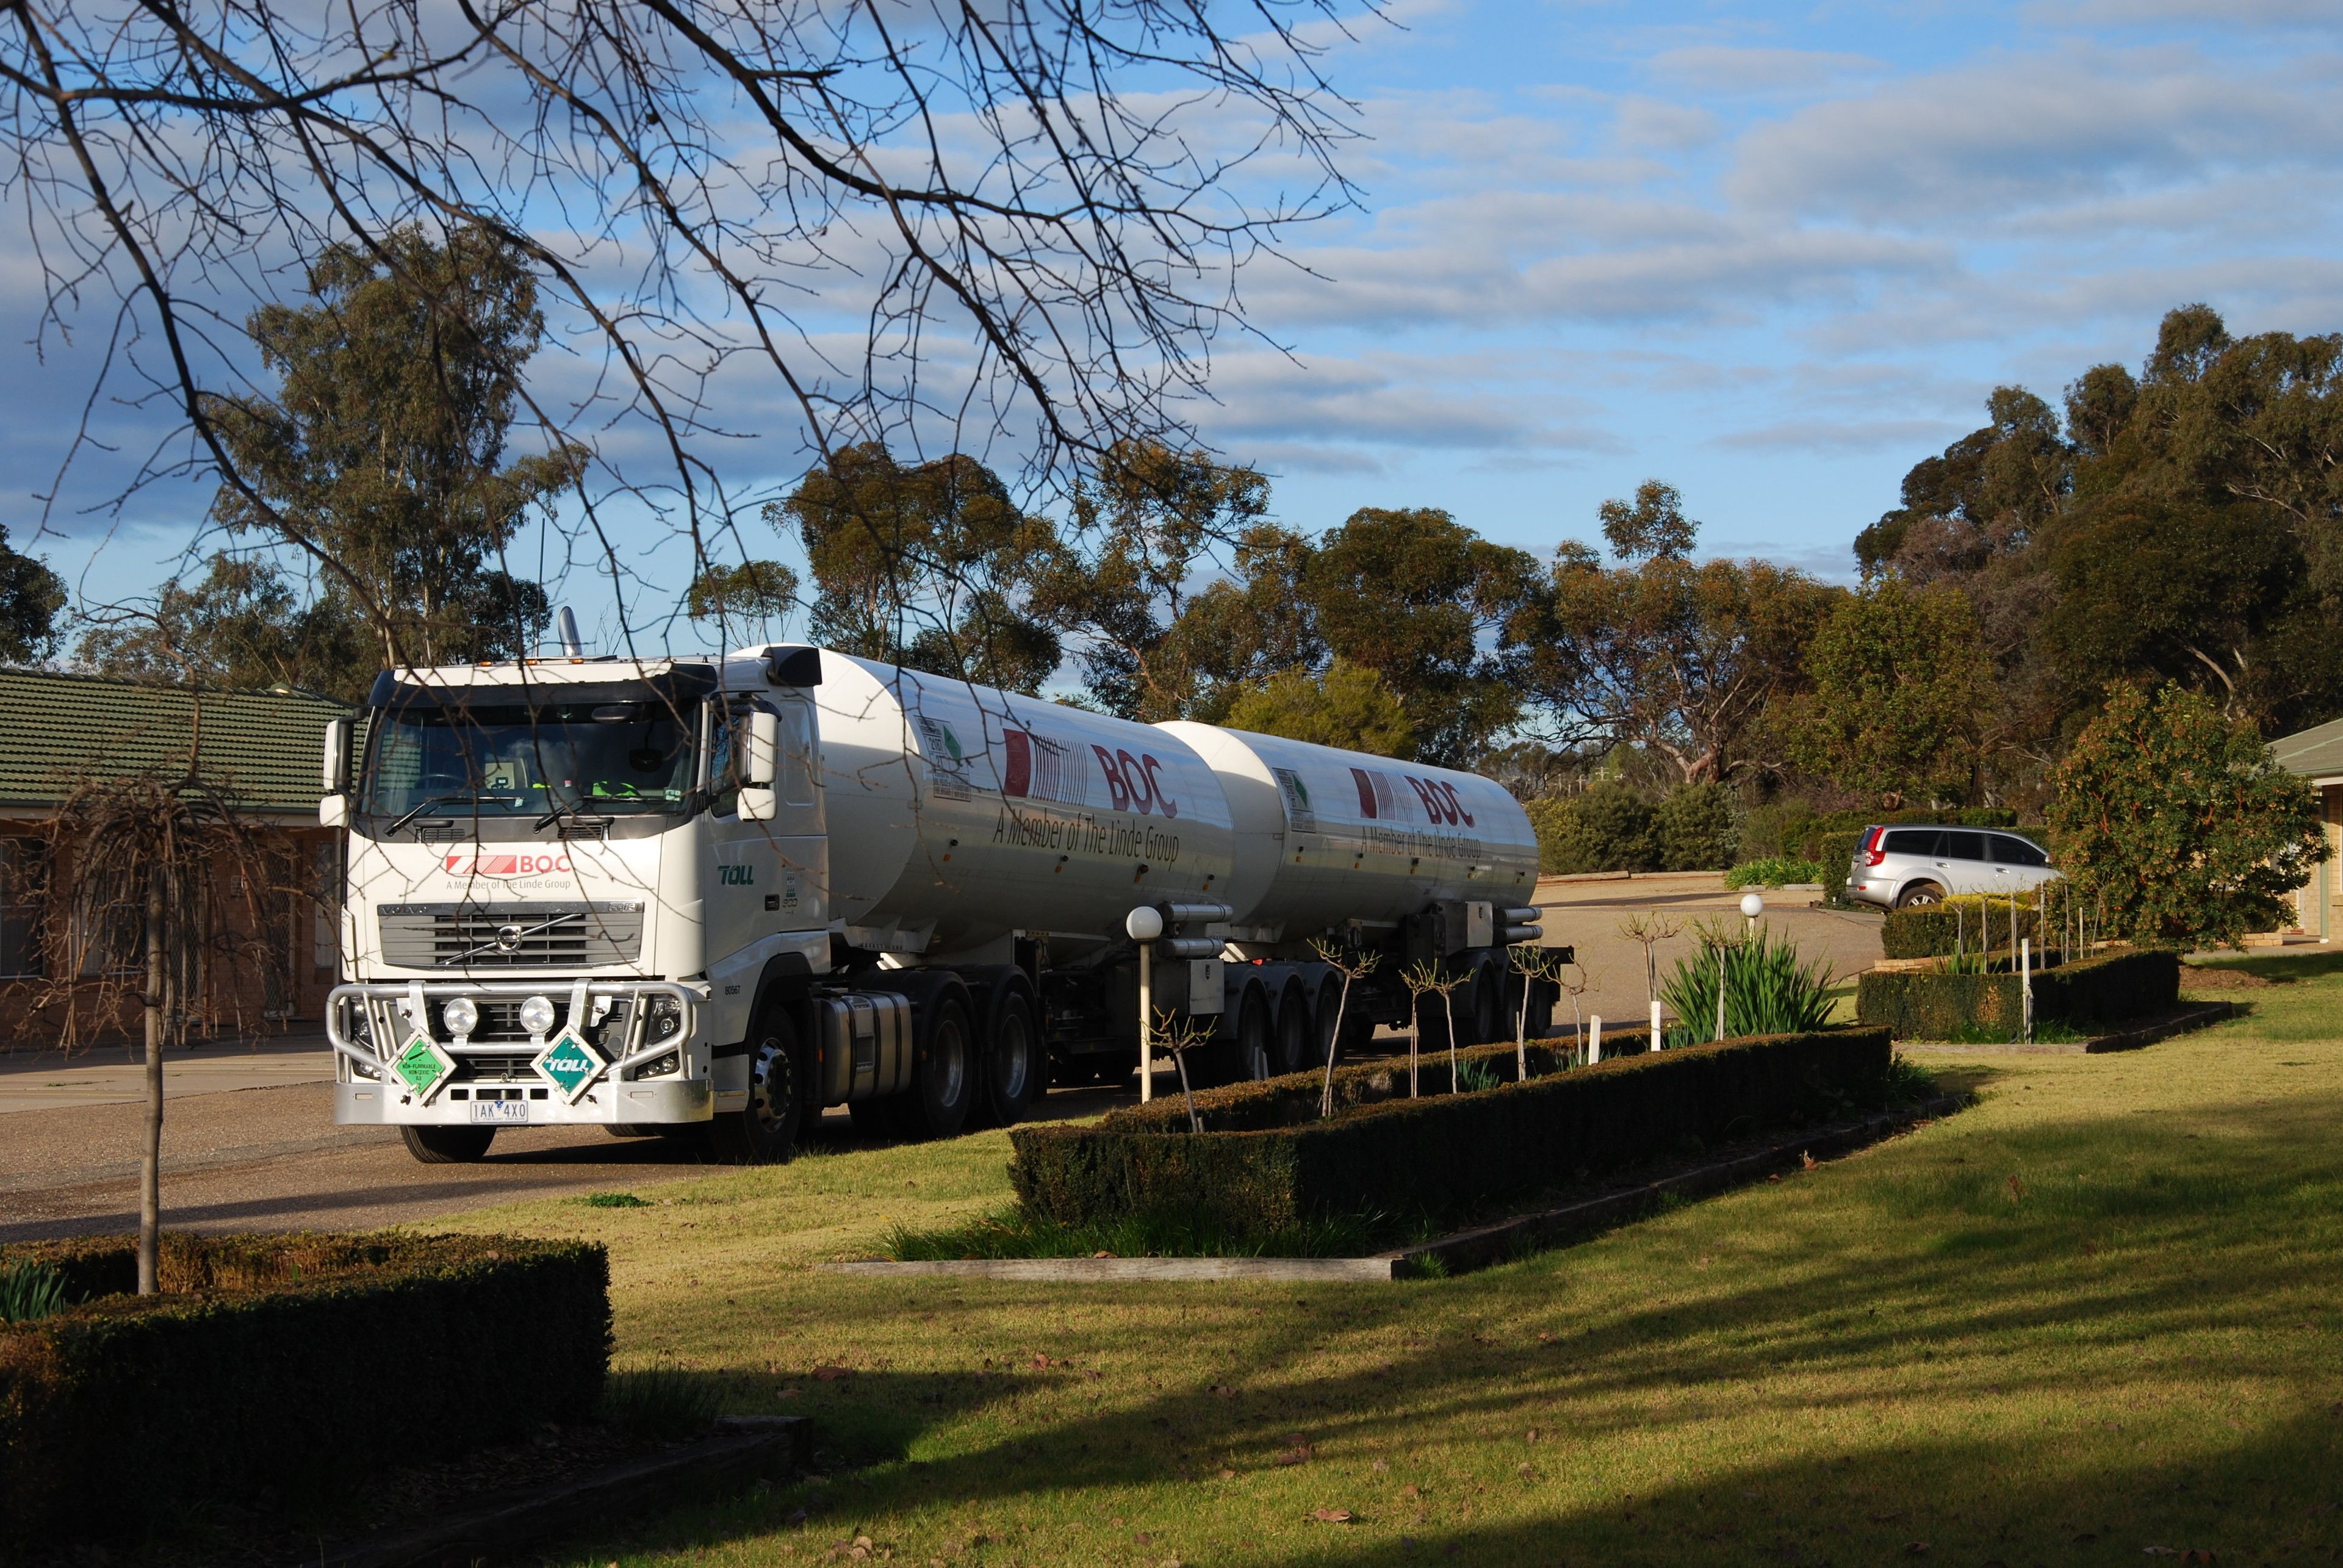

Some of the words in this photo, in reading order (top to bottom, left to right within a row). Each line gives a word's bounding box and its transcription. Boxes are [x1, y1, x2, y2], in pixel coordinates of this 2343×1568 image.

[1090, 744, 1178, 819] BOC
[1404, 775, 1475, 829] BOC
[993, 807, 1004, 843] A
[1007, 807, 1065, 849] Member
[1067, 812, 1082, 852] of
[1084, 814, 1106, 855] The
[1109, 819, 1142, 858] Linde
[1145, 825, 1179, 872] Group
[1361, 825, 1367, 853] A
[1370, 824, 1405, 855] Member
[1408, 826, 1416, 857] of
[1417, 827, 1433, 857] The
[1434, 825, 1456, 859] Linde
[1458, 832, 1481, 866] Group
[520, 855, 571, 873] BOC
[446, 880, 452, 890] A
[454, 880, 489, 890] Member
[491, 879, 500, 889] of
[519, 879, 544, 889] Linde
[545, 880, 570, 890] Group
[717, 865, 754, 885] TOLL
[381, 906, 428, 915] VOLVO
[545, 1059, 589, 1072] TOLL
[475, 1104, 494, 1117] 1AK
